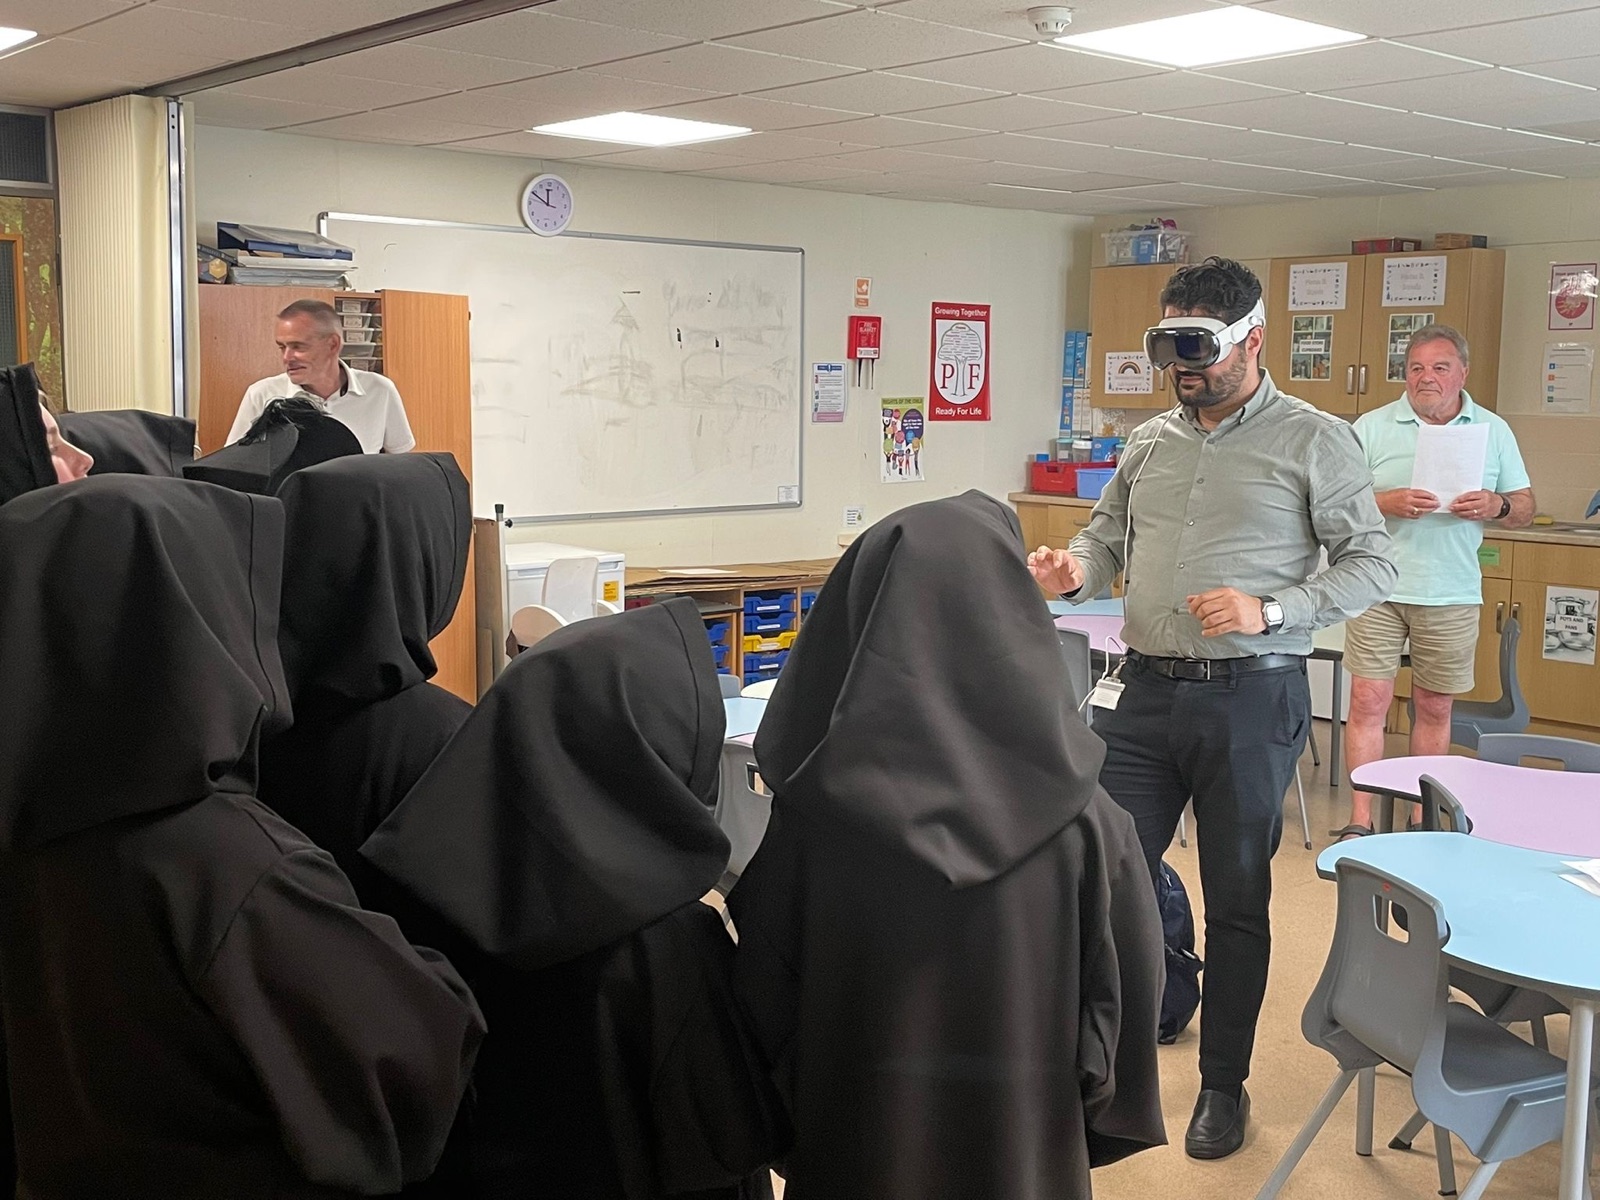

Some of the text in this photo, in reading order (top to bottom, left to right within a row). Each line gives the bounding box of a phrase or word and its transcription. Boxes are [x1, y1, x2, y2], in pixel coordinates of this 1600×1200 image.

[934, 306, 988, 318] Growing Together
[940, 363, 980, 389] P F
[935, 406, 982, 416] Ready For Life
